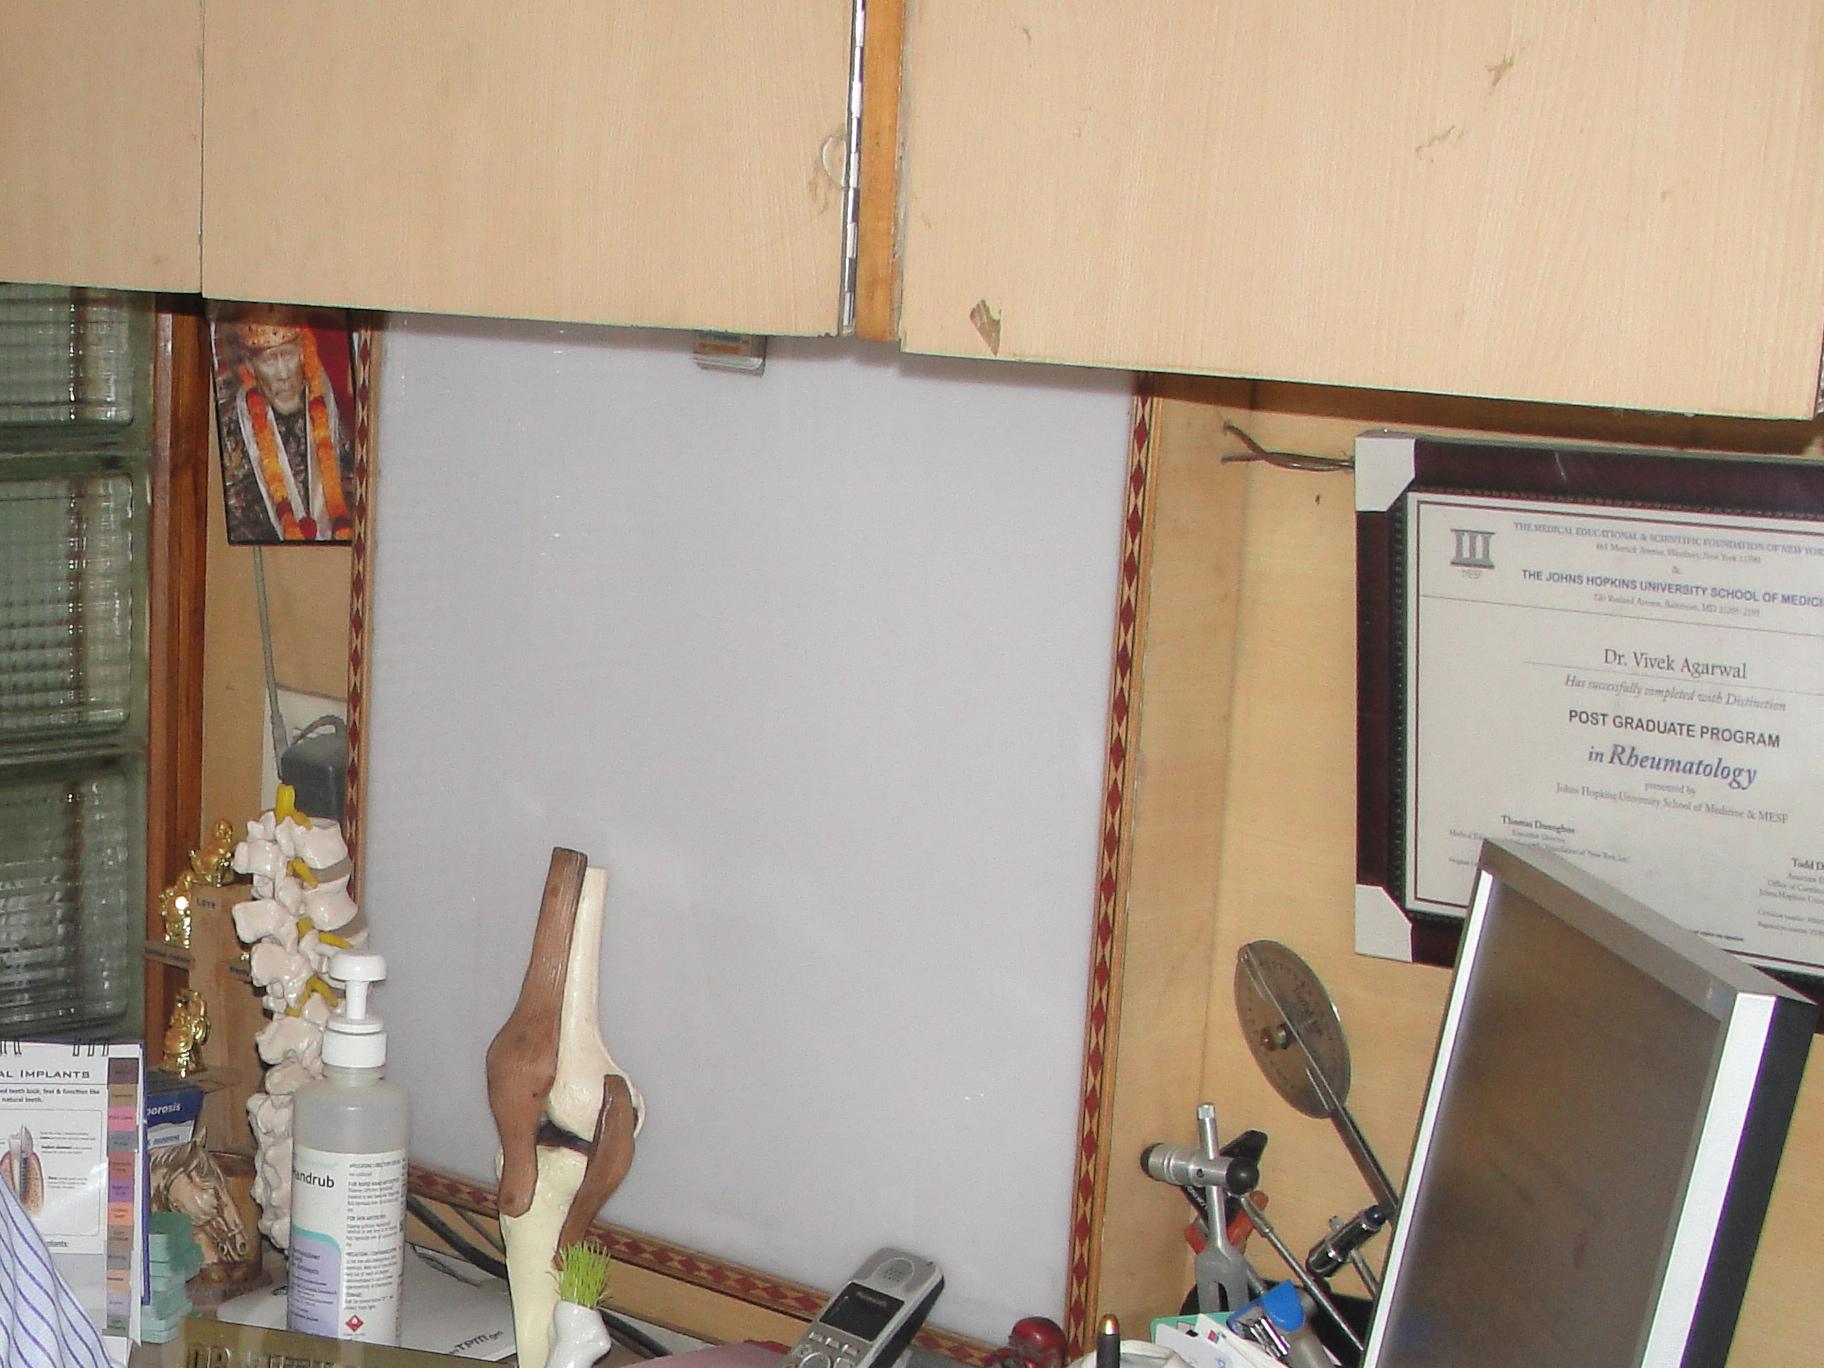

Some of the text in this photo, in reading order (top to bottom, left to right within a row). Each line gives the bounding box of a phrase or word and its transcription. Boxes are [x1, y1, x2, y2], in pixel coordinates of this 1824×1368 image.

[1522, 568, 1544, 581] THE
[1546, 571, 1584, 585] JOHNS
[1586, 575, 1637, 590] HOPKINS
[1640, 580, 1709, 598] UNIVERSITY
[1711, 587, 1760, 603] SCHOOL
[1763, 592, 1781, 605] OF
[1603, 648, 1748, 680] Dr. Vivek Agarwal
[1564, 674, 1788, 713] Has successfully completed with Distinction
[1568, 708, 1782, 749] POST GRADUATE PROGRAM
[1587, 742, 1758, 791] in Rheumatology
